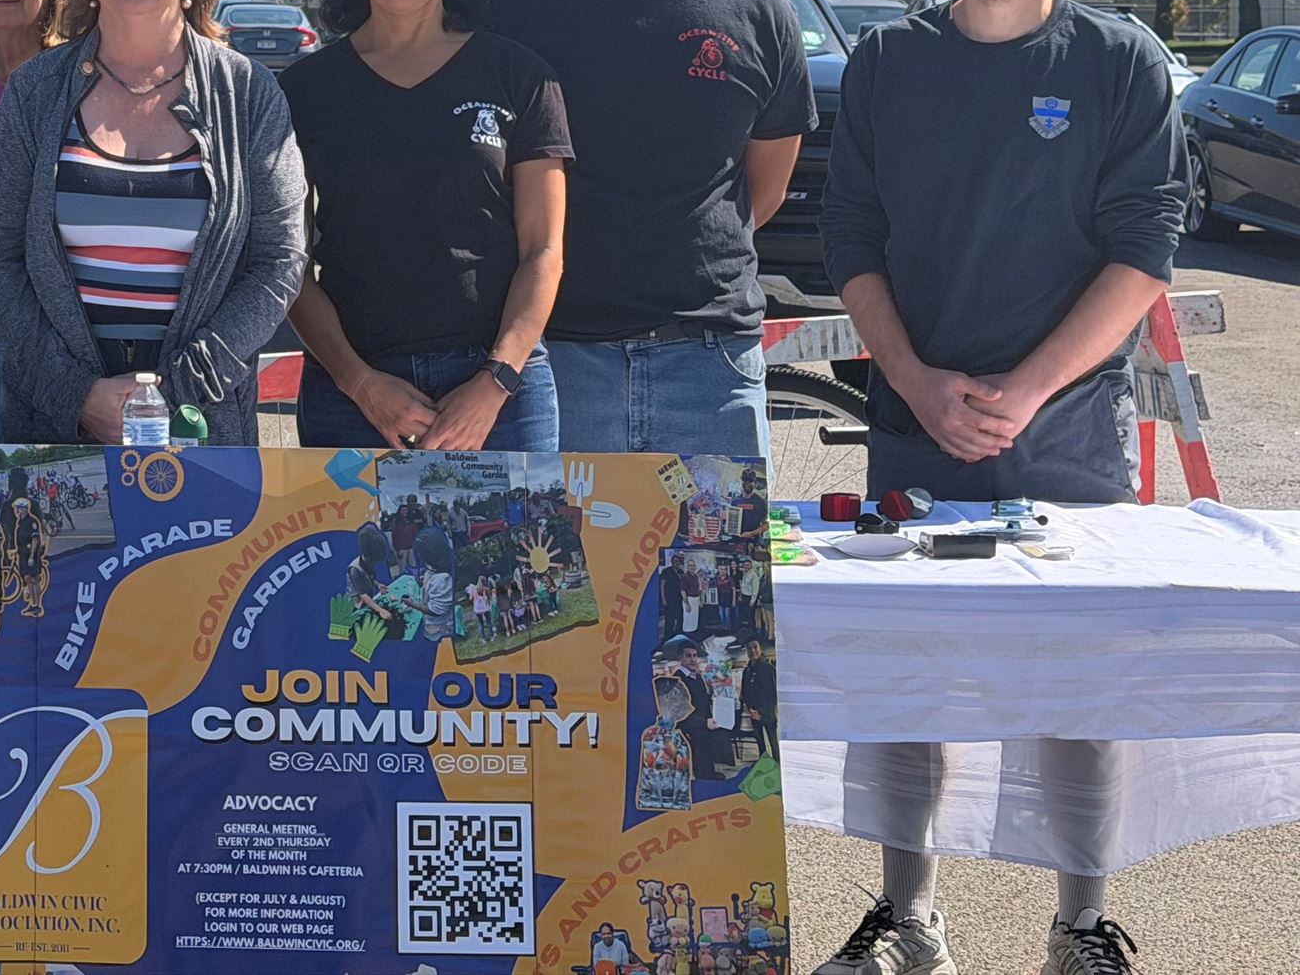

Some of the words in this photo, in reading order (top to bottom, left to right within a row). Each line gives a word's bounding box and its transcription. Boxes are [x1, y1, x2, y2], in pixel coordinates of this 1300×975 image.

[688, 66, 727, 81] CYCLE
[445, 452, 478, 462] Baldwin
[461, 461, 504, 474] Community
[482, 471, 508, 479] Garden
[657, 458, 679, 476] MENU
[192, 499, 351, 662] COMMUNITY
[54, 581, 96, 671] BIKE
[98, 519, 233, 581] PARADE
[232, 540, 333, 650] GARDEN
[600, 593, 634, 702] CASH
[621, 507, 677, 590] MOB
[241, 669, 389, 705] JOIN
[432, 671, 558, 709] OUR
[191, 707, 599, 747] COMMUNITY!
[269, 751, 368, 773] SCAN
[377, 752, 424, 774] QR
[433, 754, 528, 775] CODE
[222, 795, 318, 811] ADVOCACY
[223, 823, 270, 834] GENERAL
[217, 837, 250, 847] EVERY
[252, 837, 274, 847] 2ND
[277, 837, 331, 847] THURSDAY
[231, 850, 245, 859] OF
[248, 850, 266, 860] THE
[268, 850, 307, 861] MONTH
[177, 863, 191, 873] AT
[194, 864, 232, 874] 7:30PM
[242, 864, 291, 876] BALDWIN
[293, 865, 307, 876] HS
[309, 866, 364, 877] CAFETERIA
[559, 871, 618, 944] AND
[618, 807, 752, 875] CRAFTS
[62, 896, 108, 912] CIVIC
[196, 892, 238, 905] (EXCEPT
[239, 893, 260, 904] FOR
[262, 893, 288, 905] JULY
[289, 894, 298, 905] &
[300, 895, 346, 908] AUGUST)
[205, 907, 226, 918] FOR
[228, 908, 258, 918] MORE
[260, 908, 334, 920] INFORMATION
[88, 918, 121, 934] INC.
[204, 922, 238, 933] LOGIN
[239, 922, 254, 933] TO
[256, 923, 279, 934] OUR
[281, 924, 304, 934] WEB
[306, 924, 334, 935] PAGE
[51, 943, 70, 953] 2011
[176, 936, 366, 951] HTTPS://WWW.BALDWINCIVIC.ORG/
